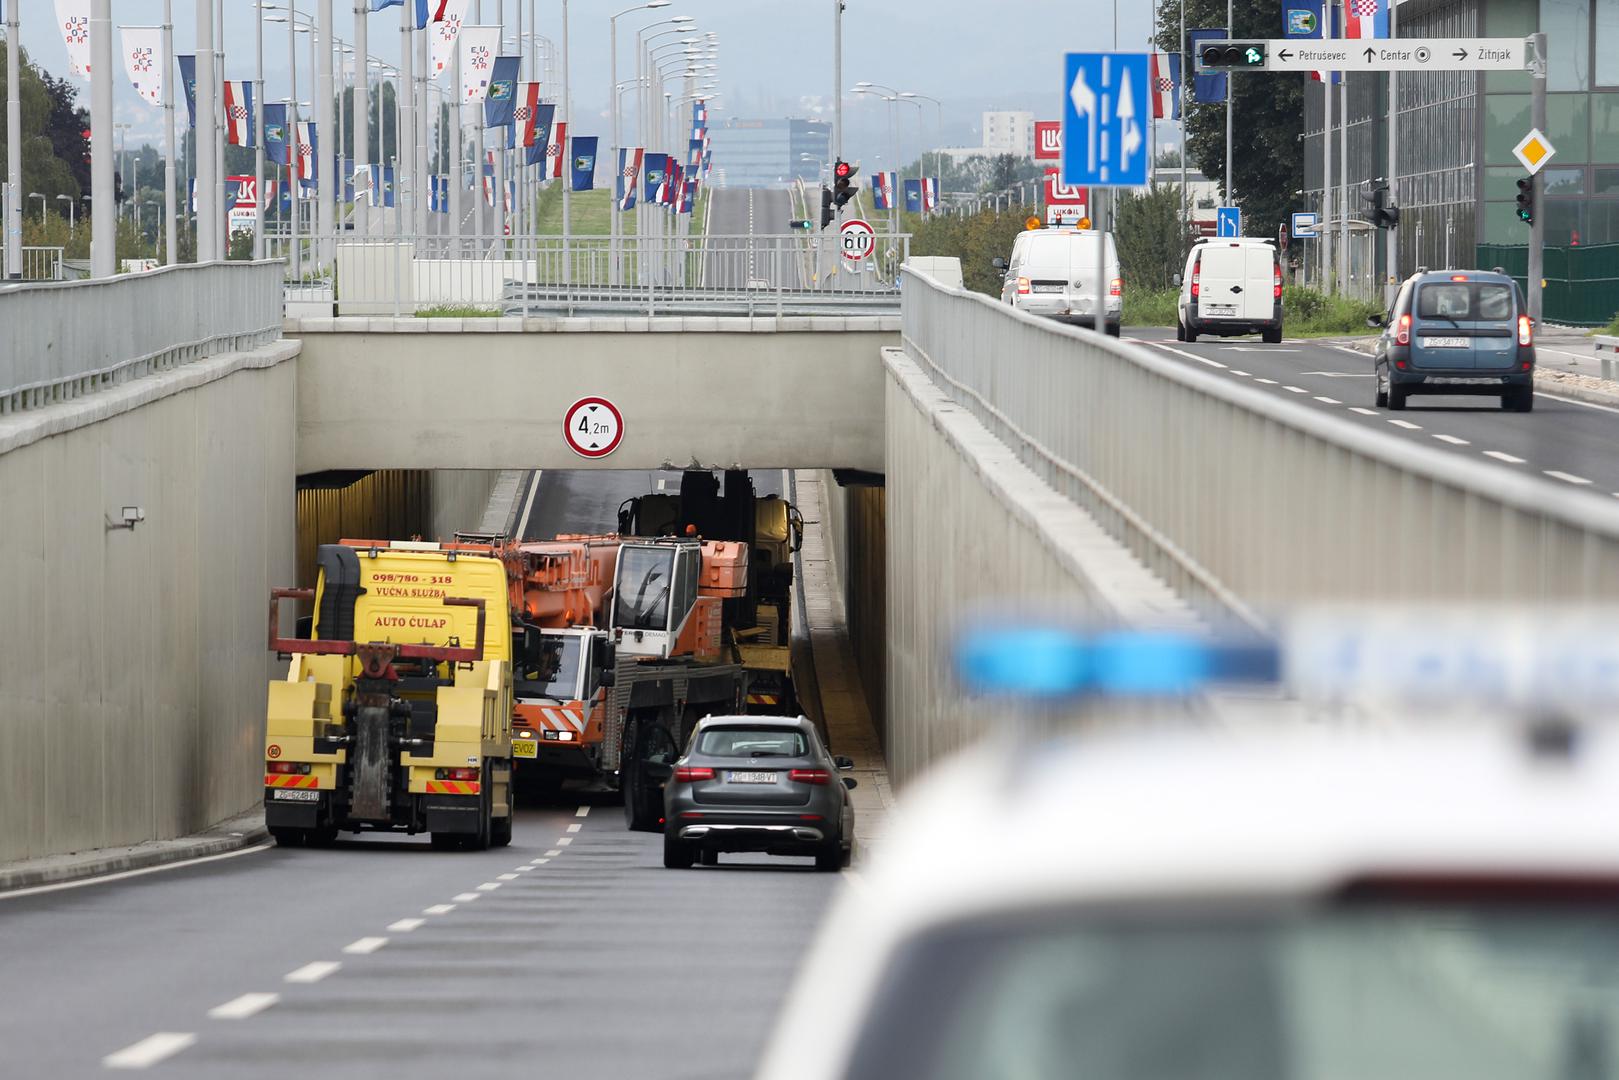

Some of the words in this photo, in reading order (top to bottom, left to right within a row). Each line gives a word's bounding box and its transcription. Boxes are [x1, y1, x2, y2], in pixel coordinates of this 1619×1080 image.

[1299, 50, 1346, 60] Petruševec
[1380, 50, 1411, 60] Centar
[1478, 48, 1511, 62] Žitnjak
[845, 231, 867, 249] 60
[372, 574, 419, 583] 098/780
[431, 576, 452, 584] 318
[374, 617, 406, 627] AUTO
